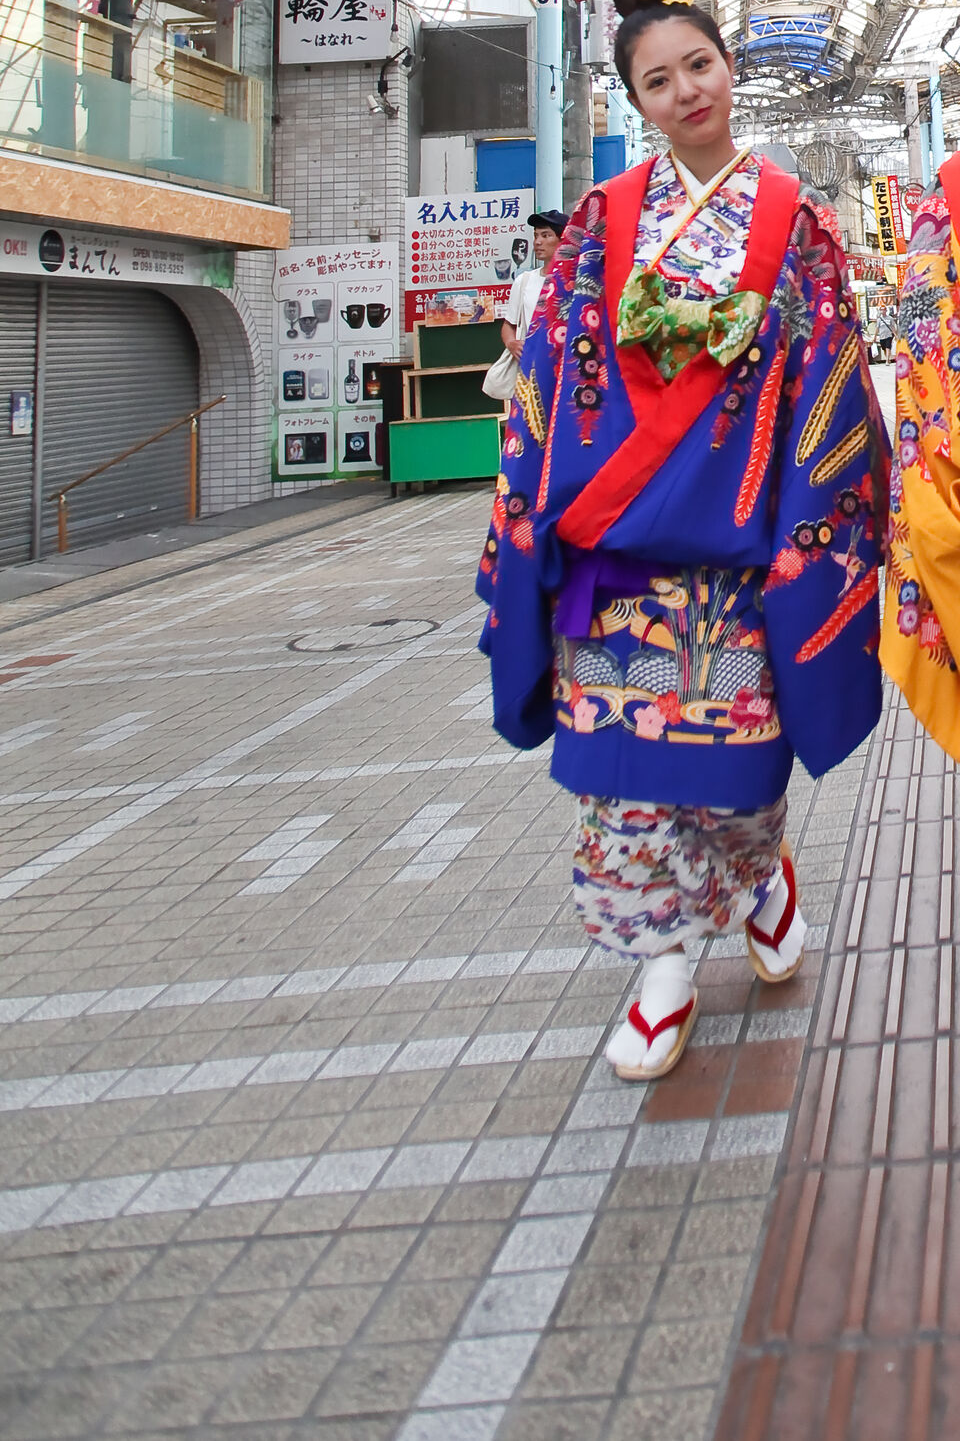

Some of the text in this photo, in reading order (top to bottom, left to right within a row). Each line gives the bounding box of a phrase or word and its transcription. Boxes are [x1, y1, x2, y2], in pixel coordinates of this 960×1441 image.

[417, 197, 520, 224] 名入れ工房
[420, 224, 526, 239] 大切な方への感謝をこめて
[420, 238, 490, 250] 自分へのご褒美に
[133, 248, 150, 259] OPEN
[420, 248, 500, 262] お友達のおみやげに
[69, 246, 120, 276] まんてん
[420, 260, 491, 272] 恋人とおそろいで
[420, 272, 473, 283] 旅の思い出に
[296, 288, 319, 296] グラス
[346, 285, 383, 294] マグカップ
[293, 353, 322, 361] ライター
[284, 418, 329, 427] フォトフレーム
[353, 415, 376, 423] その他
